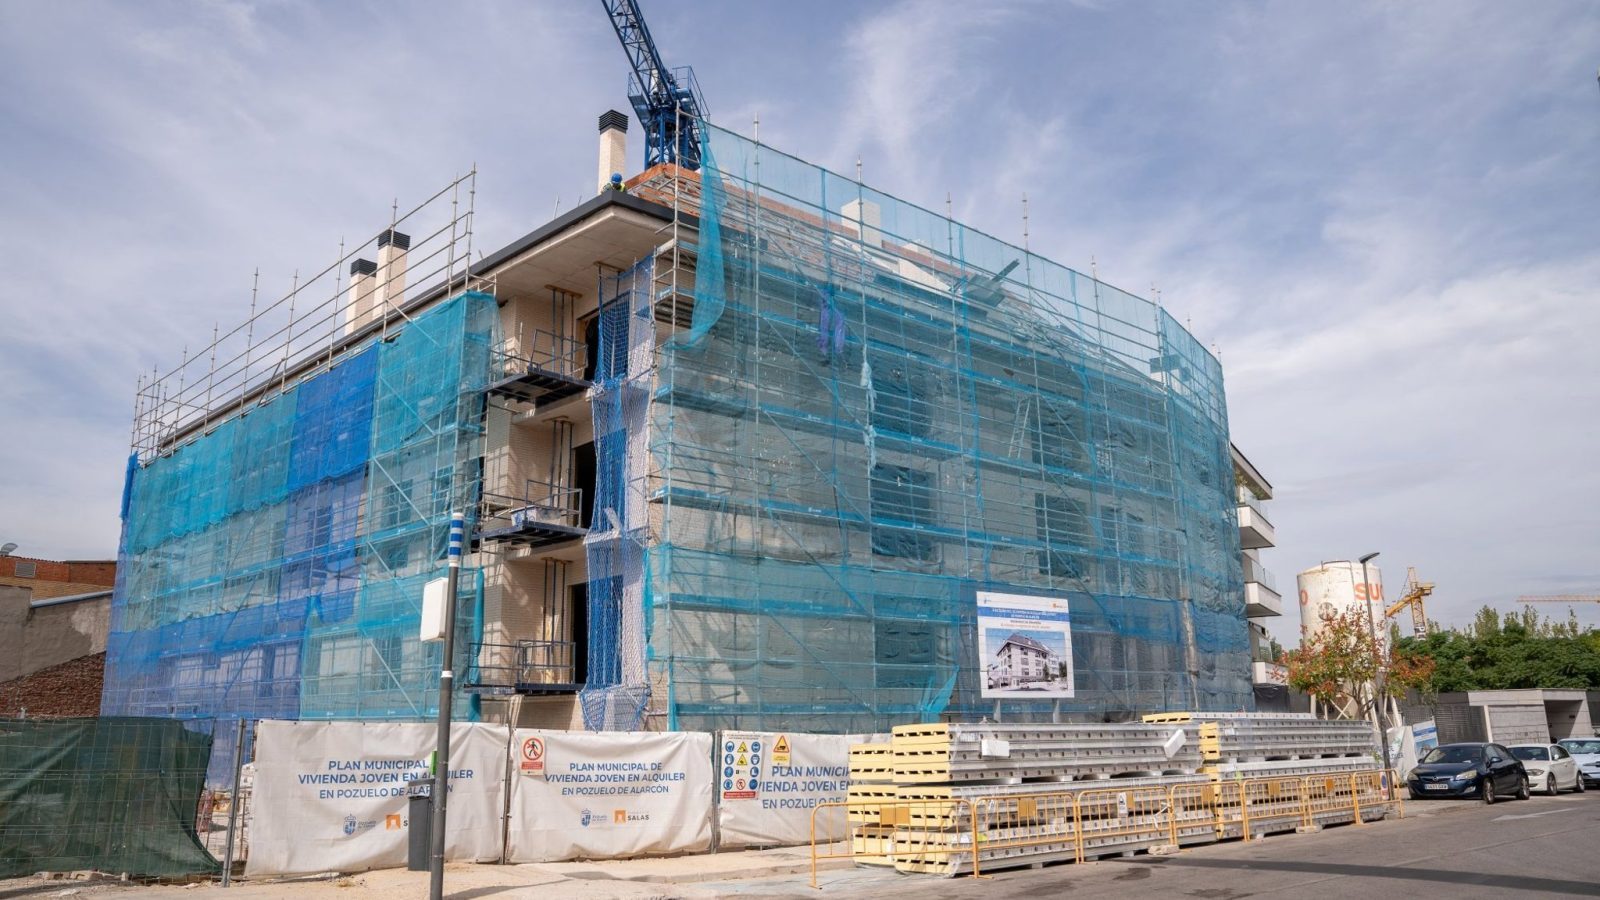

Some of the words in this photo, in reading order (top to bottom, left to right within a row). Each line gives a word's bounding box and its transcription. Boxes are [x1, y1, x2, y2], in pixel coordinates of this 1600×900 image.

[328, 761, 361, 771] PLAN
[364, 760, 429, 770] MUNICIPAL
[570, 763, 594, 772] PLAN
[597, 762, 648, 771] MUNICIPAL
[651, 762, 662, 771] DE
[772, 766, 803, 777] PLAN
[298, 774, 357, 784] VIVIENDA
[360, 773, 399, 783] JOVEN
[402, 772, 418, 782] EN
[545, 774, 593, 783] VIVIENDA
[595, 774, 626, 783] JOVEN
[628, 773, 639, 782] EN
[641, 772, 686, 782] ALQUILER
[562, 787, 574, 796] EN
[576, 786, 616, 795] POZUELO
[617, 786, 629, 795] DE
[630, 784, 669, 794] ALARCÓN
[759, 781, 799, 792] IENDA
[801, 780, 837, 791] JOVEN
[319, 789, 335, 799] EN
[337, 788, 389, 798] POZUELO
[391, 787, 405, 797] DE
[762, 799, 777, 809] EN
